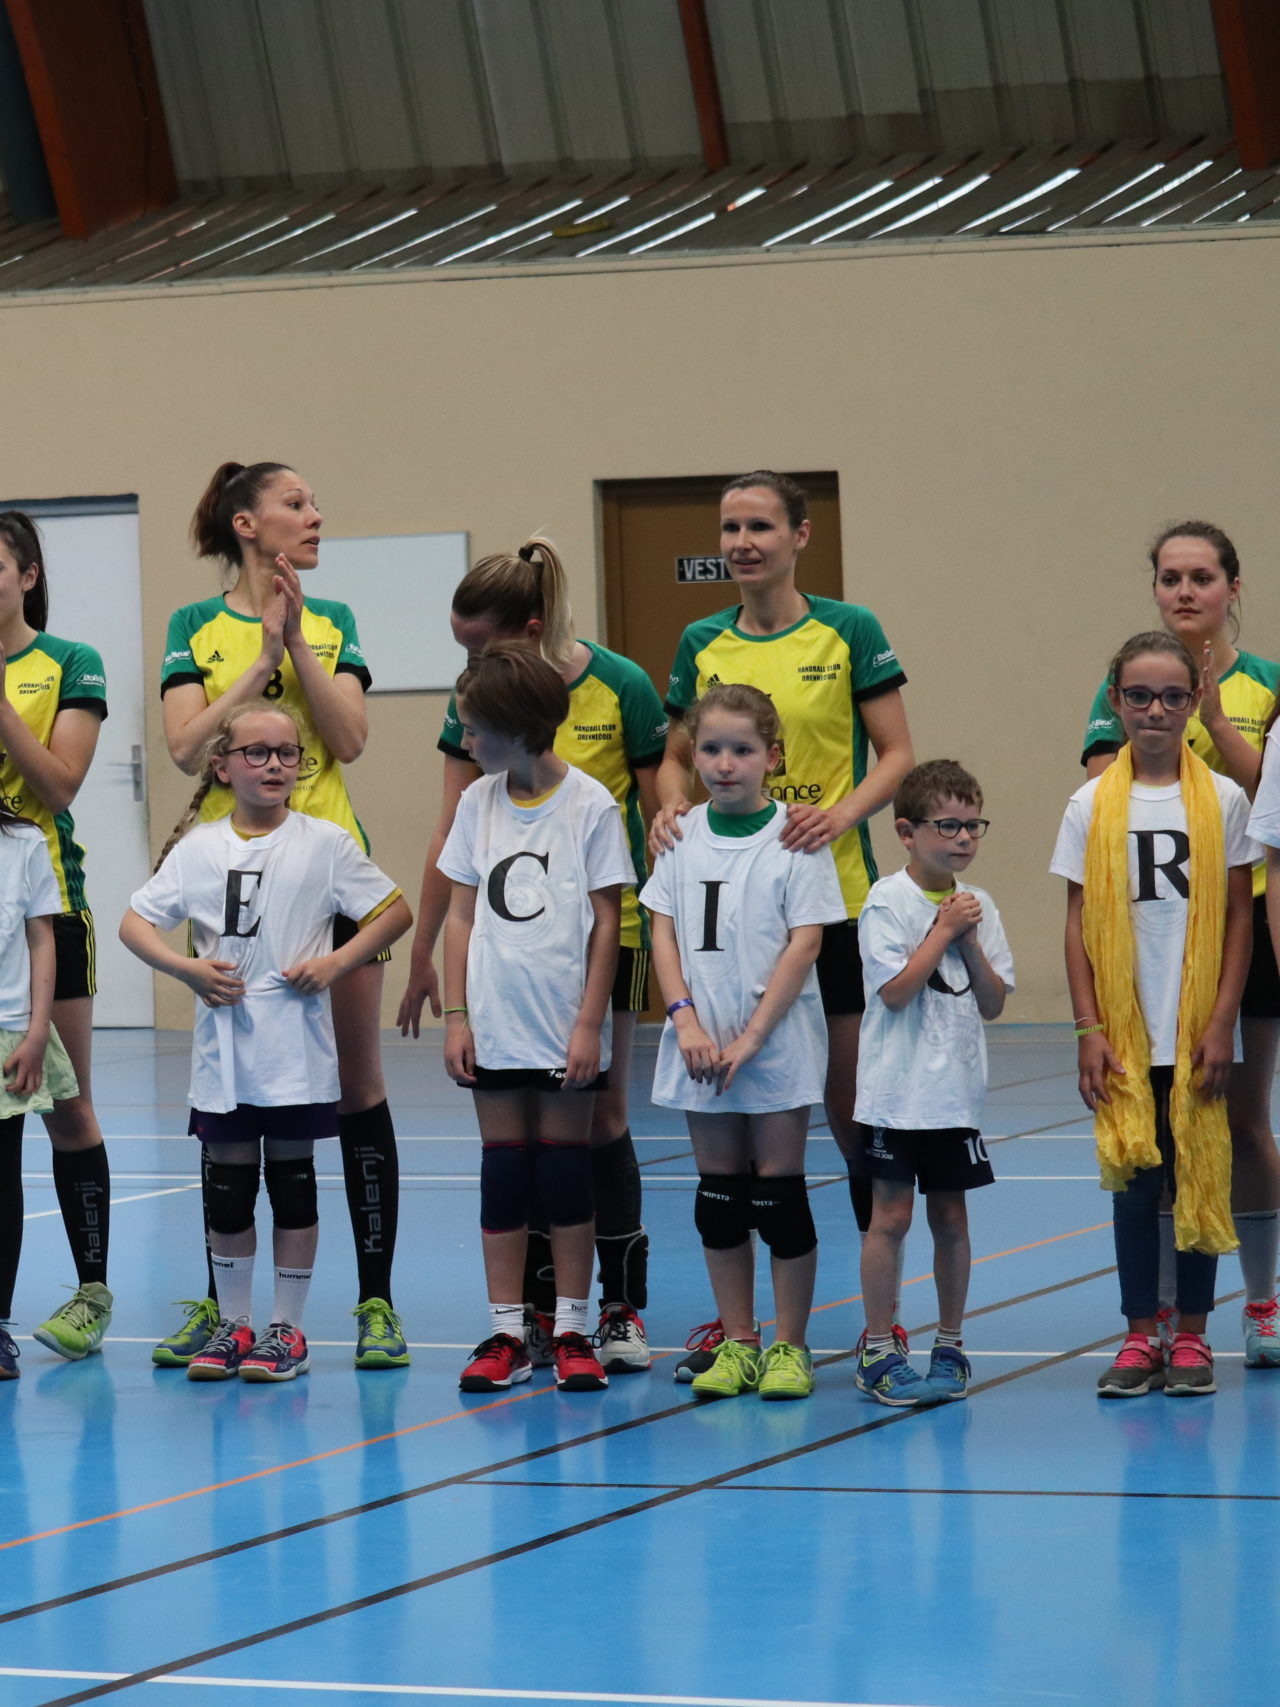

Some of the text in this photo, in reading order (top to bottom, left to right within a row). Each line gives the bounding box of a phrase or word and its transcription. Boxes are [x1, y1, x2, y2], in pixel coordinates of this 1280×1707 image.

[682, 558, 726, 581] VEST
[797, 663, 841, 673] HANDBALL CLUB
[771, 782, 820, 802] ance
[487, 851, 549, 923] C
[1128, 829, 1190, 903] R
[220, 869, 263, 938] E
[694, 880, 730, 952] I
[75, 1181, 104, 1264] Kalenji
[354, 1146, 385, 1253] Kalenji
